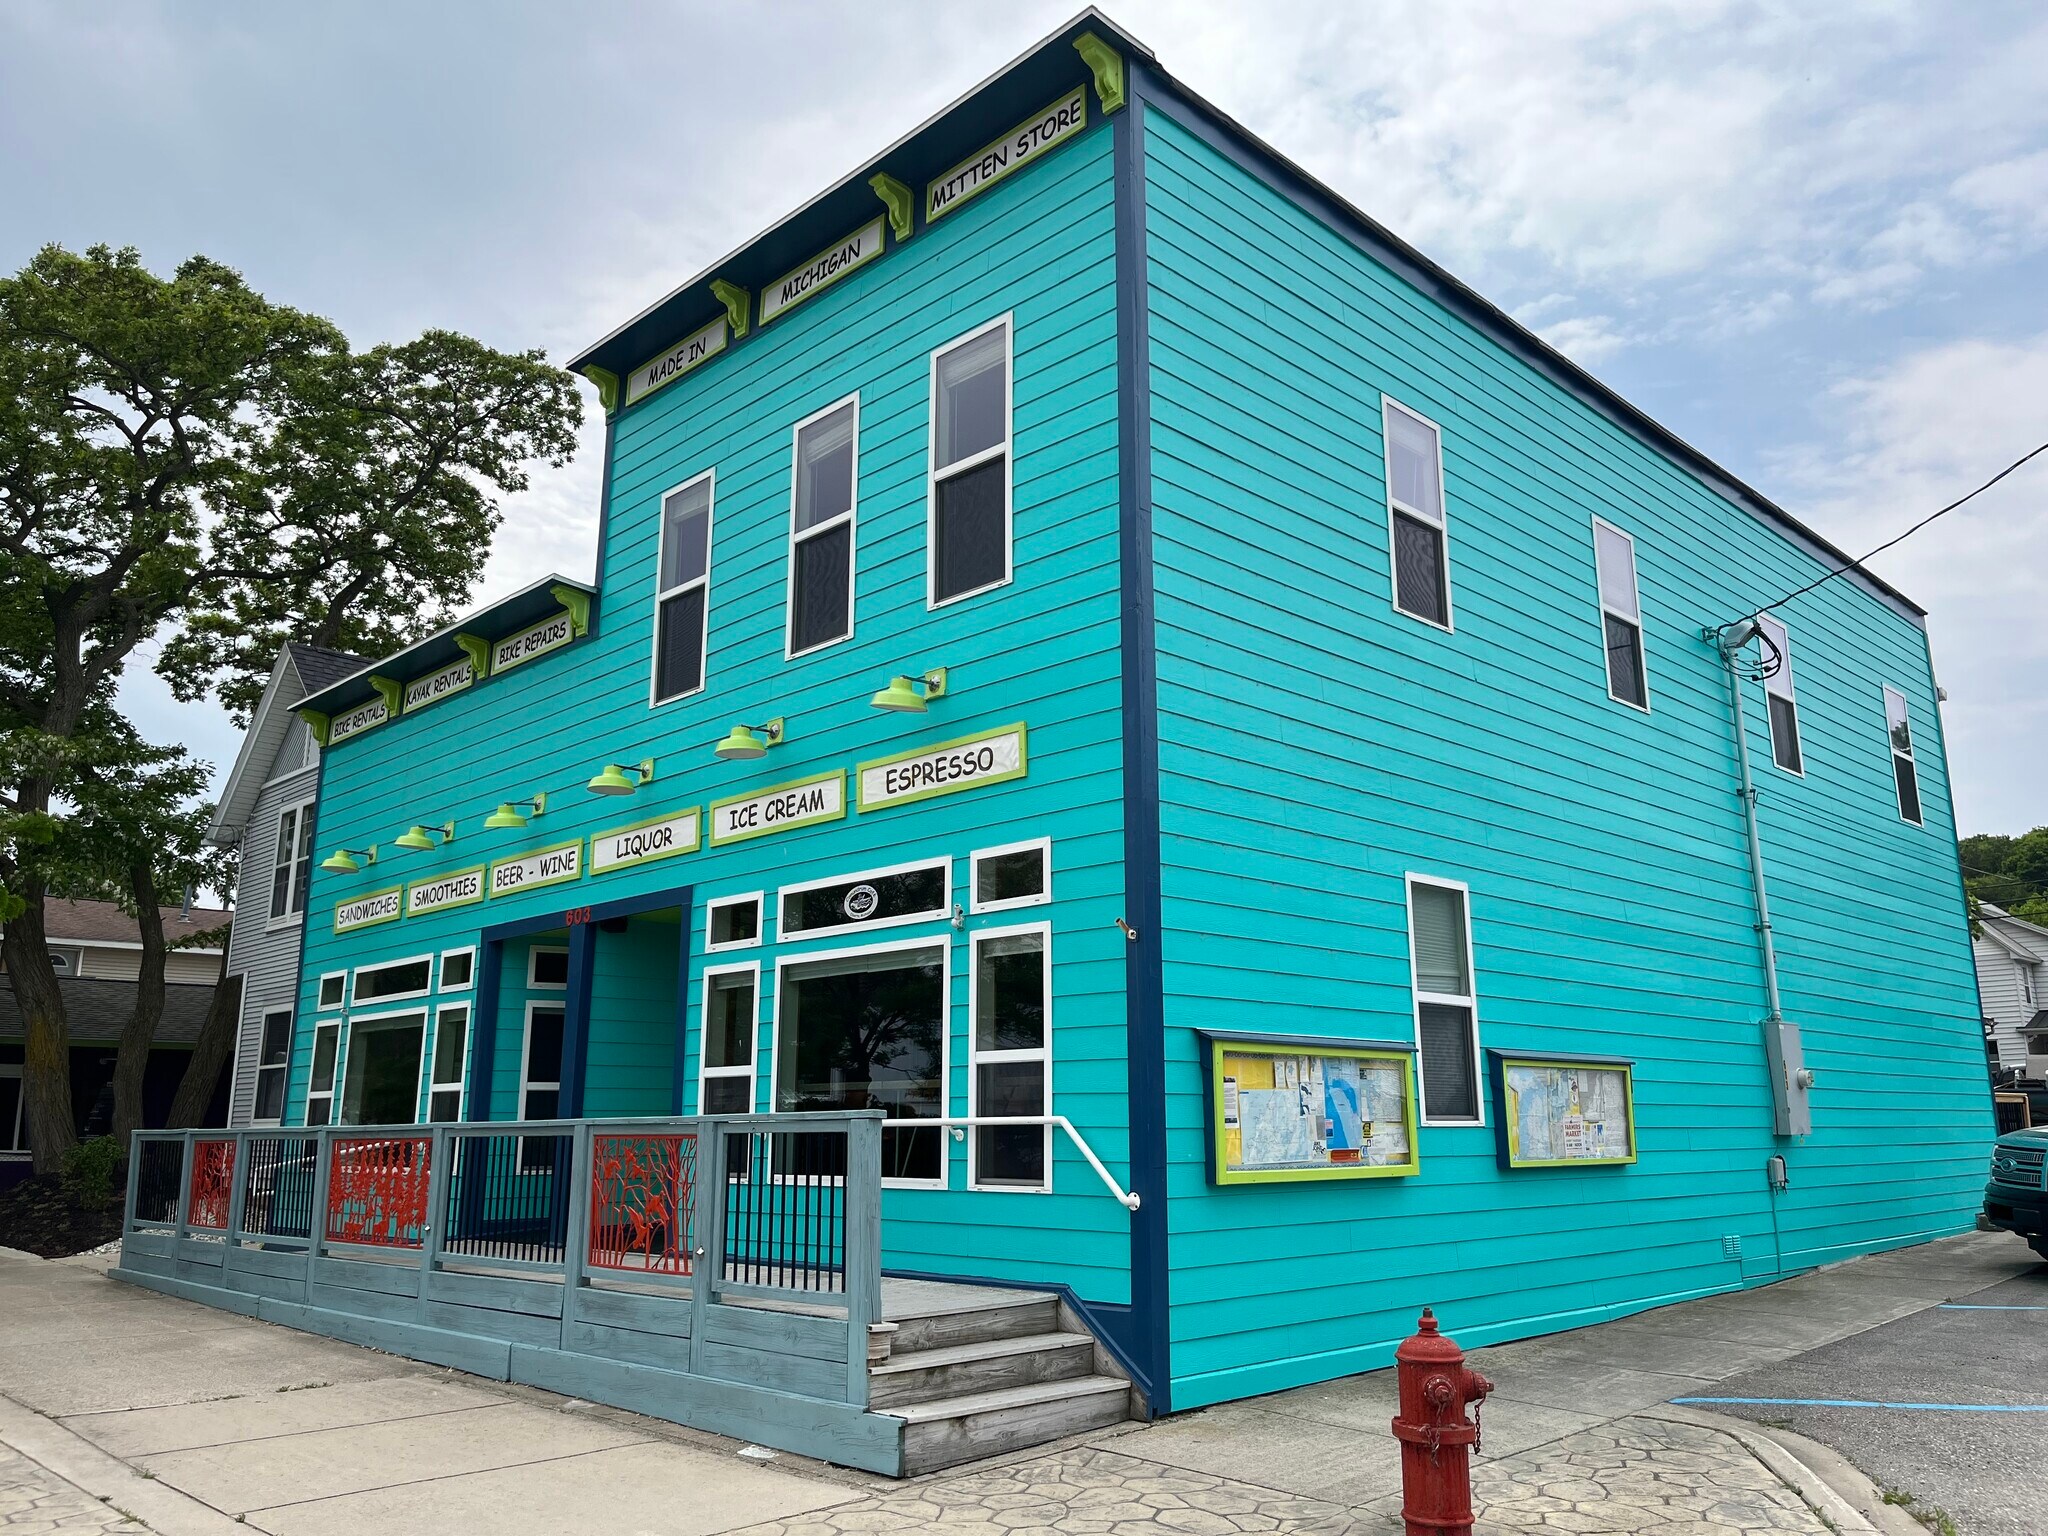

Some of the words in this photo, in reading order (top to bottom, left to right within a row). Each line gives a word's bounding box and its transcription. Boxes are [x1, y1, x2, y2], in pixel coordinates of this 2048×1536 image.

[931, 145, 1007, 213] MITTEN
[1016, 97, 1081, 159] STORE
[780, 238, 860, 305] MICHIGAN
[647, 356, 684, 387] MADE
[688, 336, 707, 363] IN
[499, 640, 522, 665] BIKE
[525, 621, 567, 654] REPAIRS
[406, 683, 431, 707] KAYAK
[434, 664, 472, 694] RENTALS
[334, 718, 351, 738] BIKE
[352, 703, 386, 729] RENTALS
[885, 746, 994, 795] ESPRESSO
[729, 804, 758, 831] ICE
[765, 788, 825, 821] CREAM
[616, 826, 673, 859] LIQUOR
[496, 865, 523, 888] BEER
[540, 850, 576, 876] WINE
[339, 896, 398, 925] SANDWICHES
[415, 877, 477, 907] SMOOTHIES
[565, 907, 592, 927] 603
